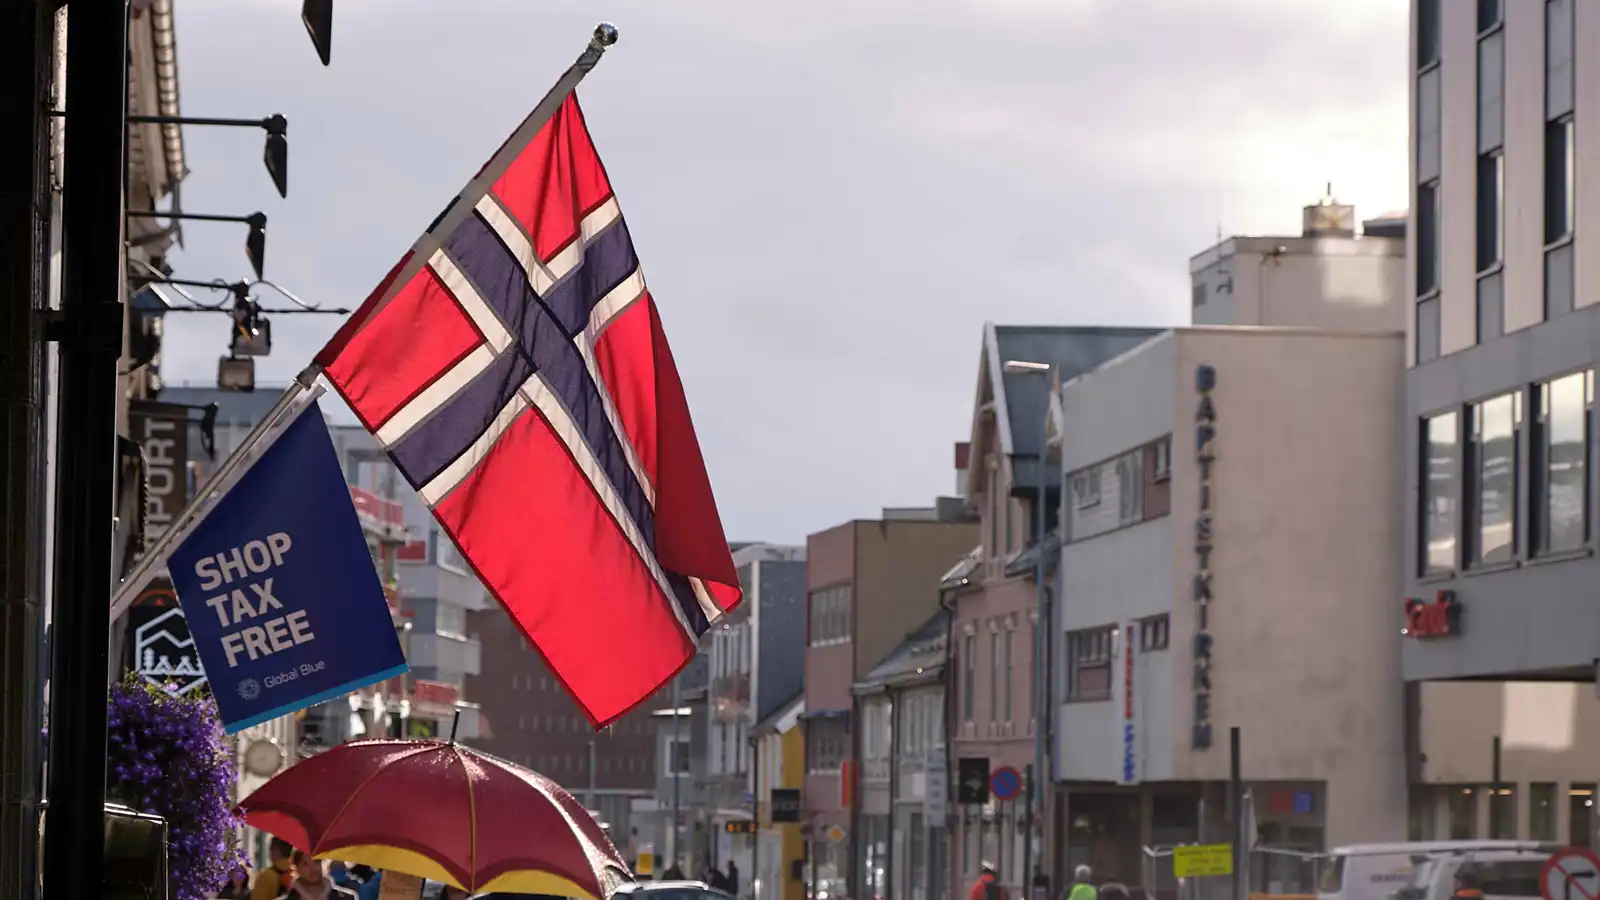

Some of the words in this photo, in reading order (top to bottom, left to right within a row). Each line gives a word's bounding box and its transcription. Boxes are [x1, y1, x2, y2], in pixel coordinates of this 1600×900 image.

[194, 532, 292, 591] SHOP
[205, 577, 284, 628] TAX
[220, 609, 315, 668] FREE
[263, 668, 299, 689] Global
[300, 660, 326, 677] Blue
